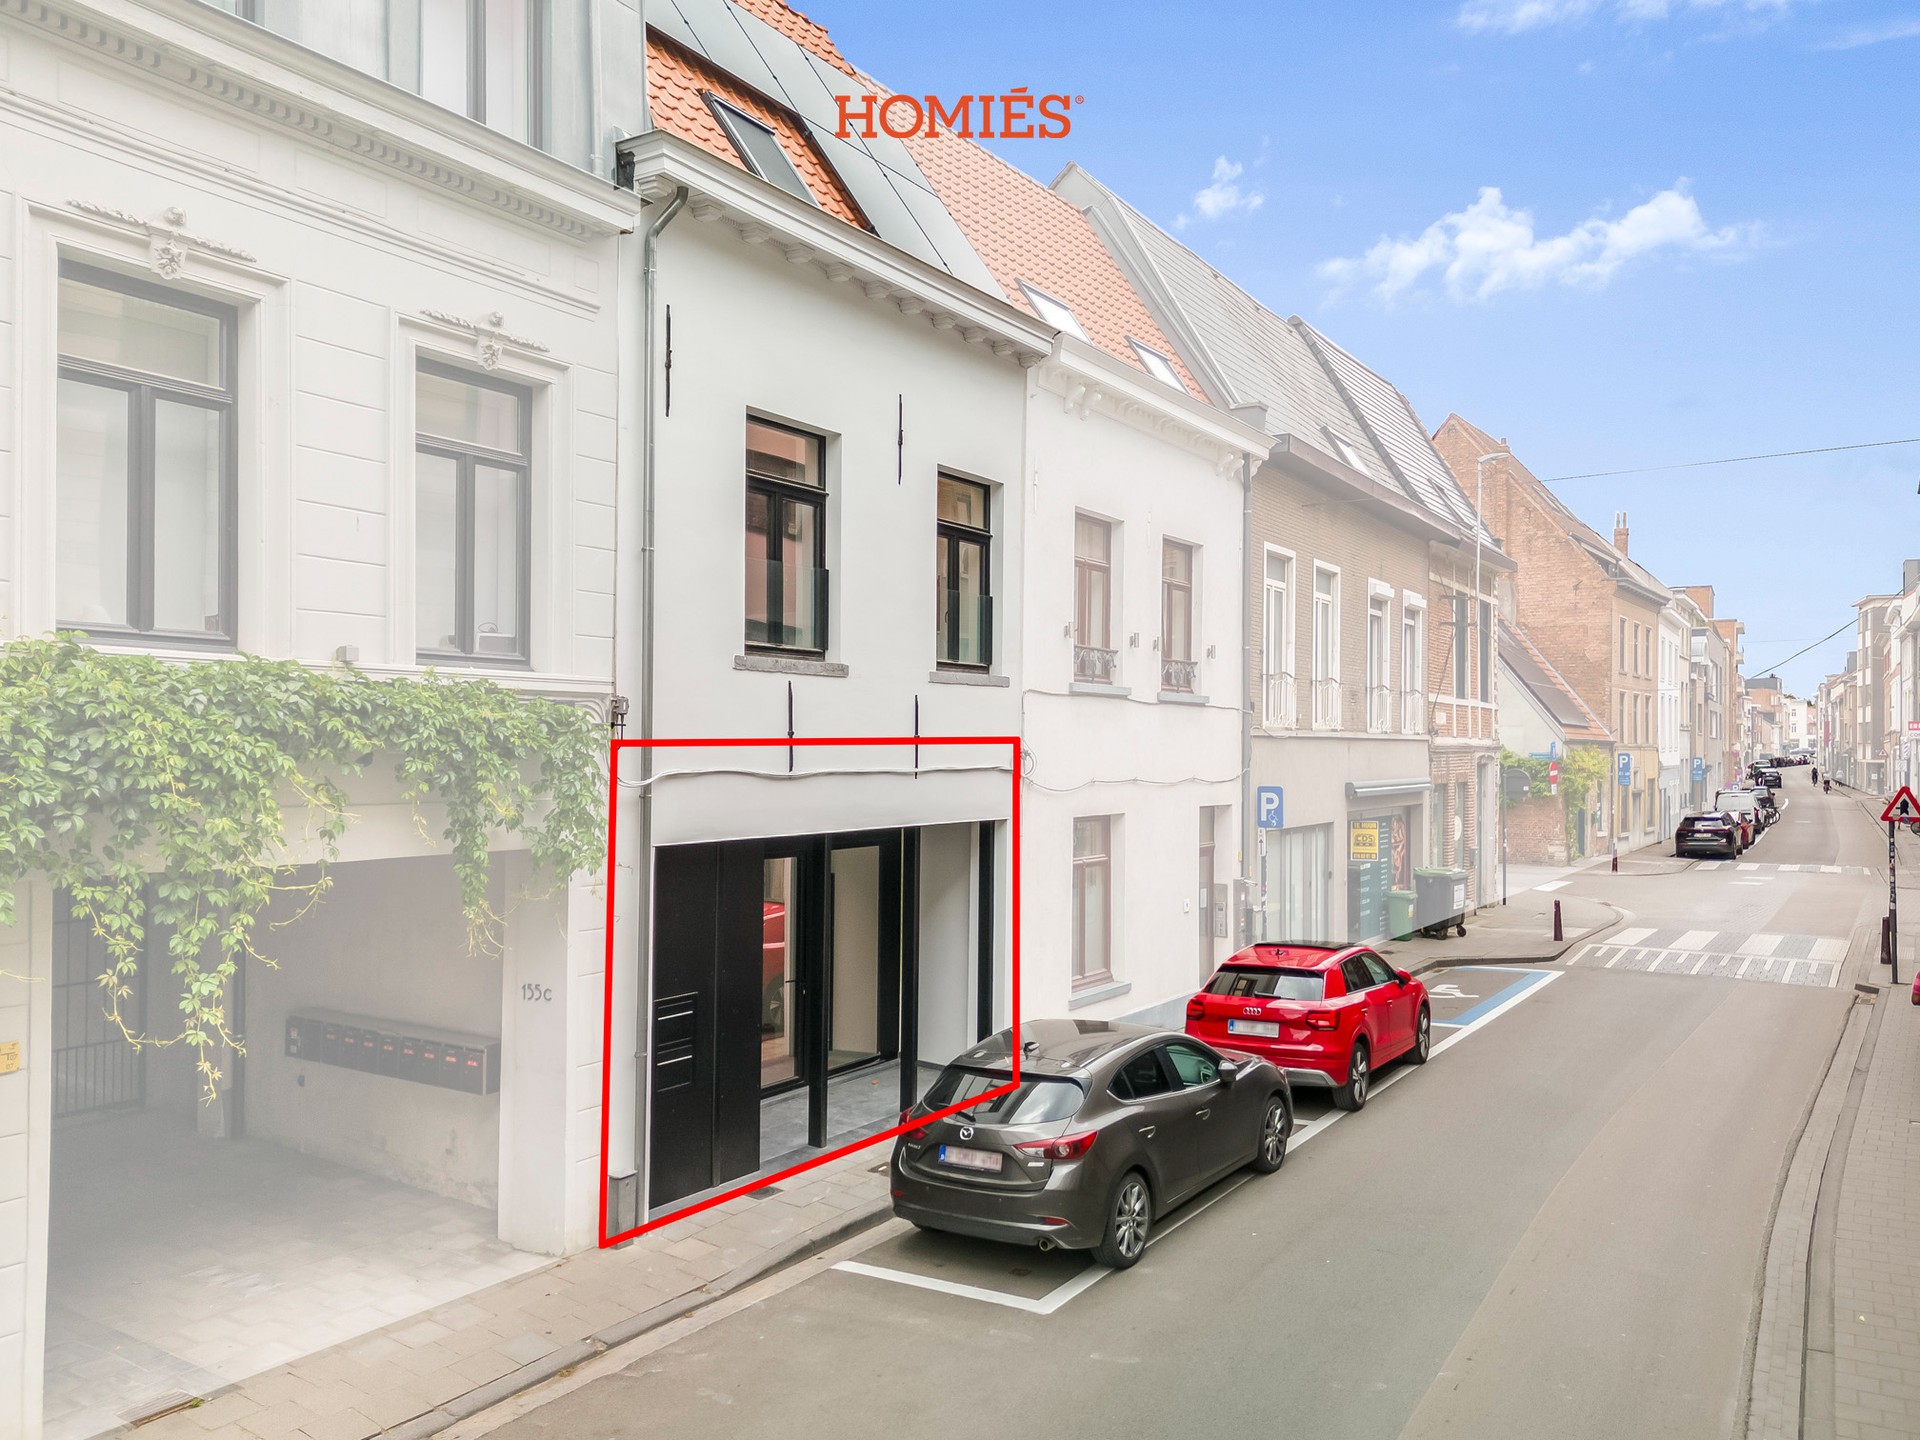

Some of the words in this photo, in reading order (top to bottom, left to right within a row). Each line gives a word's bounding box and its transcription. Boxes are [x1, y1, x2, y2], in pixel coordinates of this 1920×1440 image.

[1619, 755, 1629, 769] P
[1693, 759, 1702, 768] P
[1261, 792, 1280, 822] P
